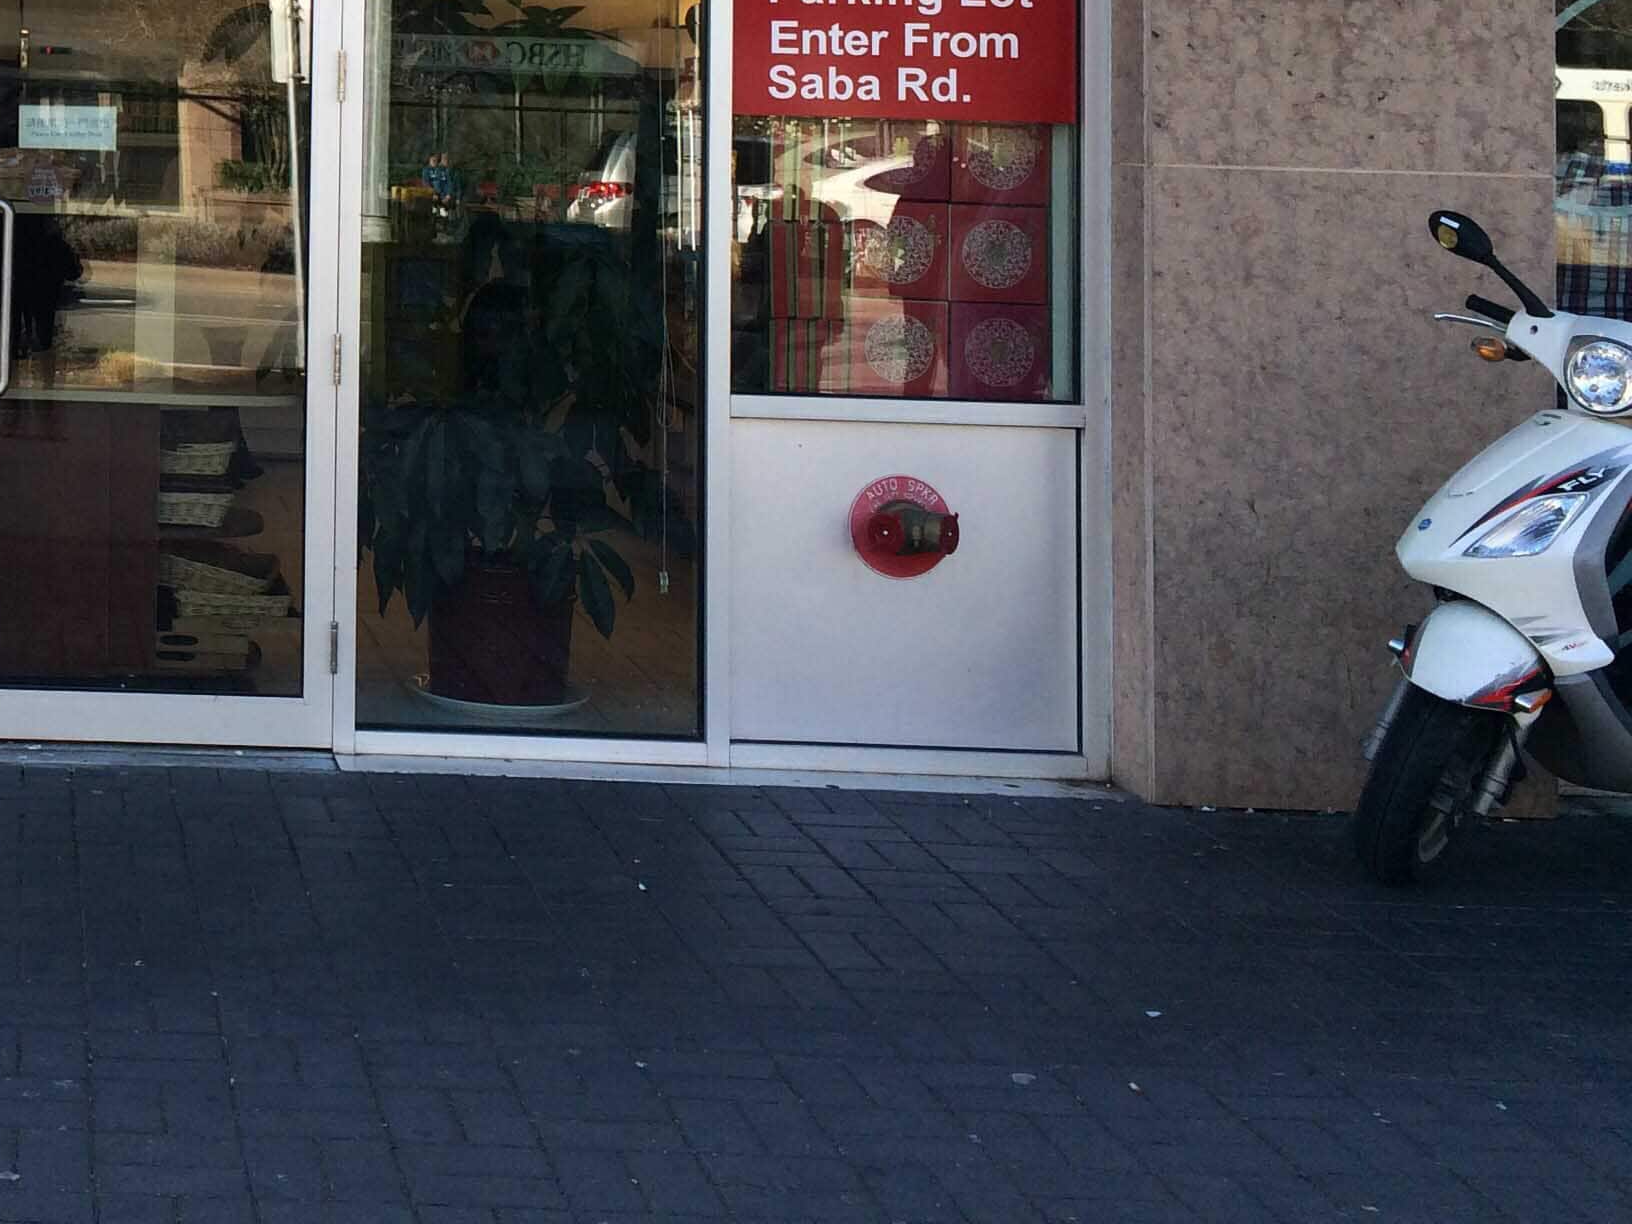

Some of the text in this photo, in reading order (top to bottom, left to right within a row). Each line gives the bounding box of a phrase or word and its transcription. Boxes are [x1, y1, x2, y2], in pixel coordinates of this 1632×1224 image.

[771, 20, 1019, 59] Enter From
[768, 64, 971, 103] Saba Rd.
[865, 478, 898, 500] AUTO
[1556, 467, 1606, 491] FLY
